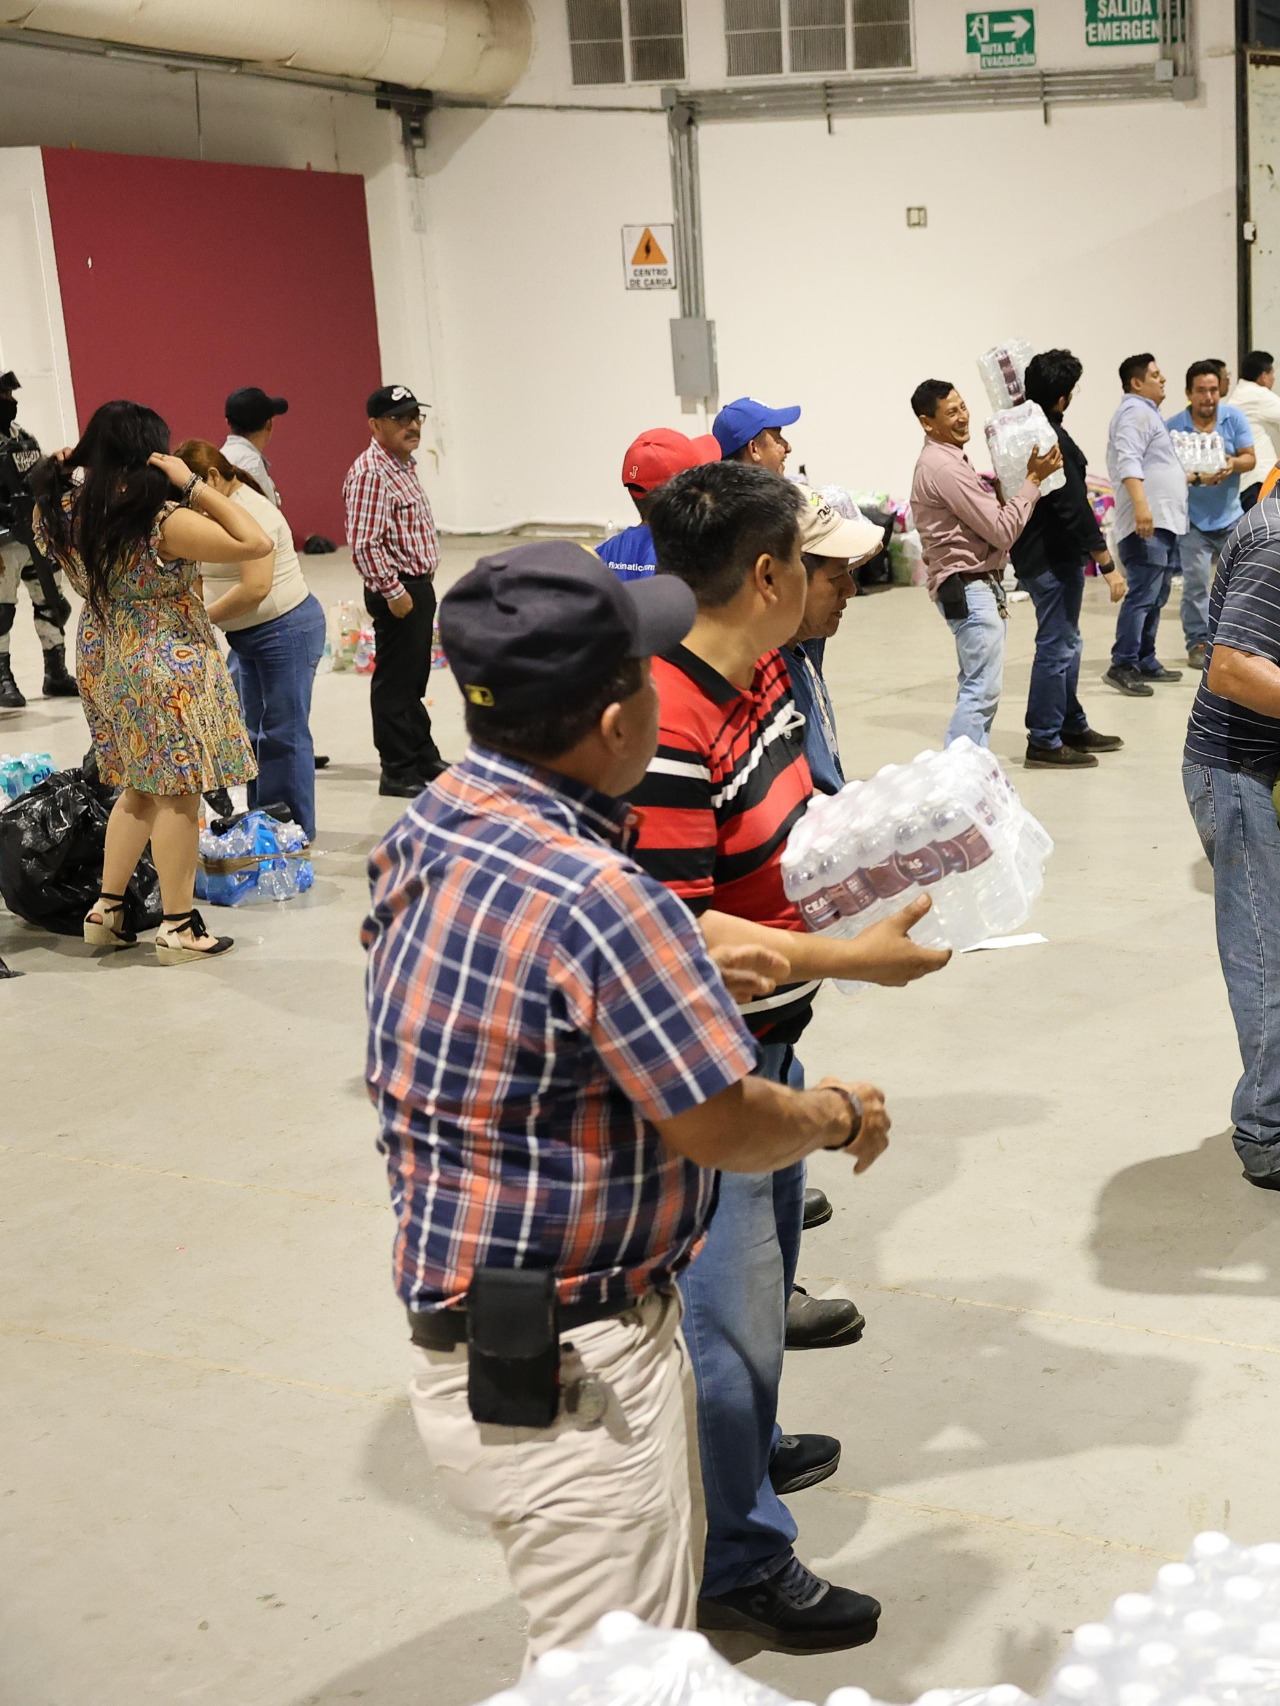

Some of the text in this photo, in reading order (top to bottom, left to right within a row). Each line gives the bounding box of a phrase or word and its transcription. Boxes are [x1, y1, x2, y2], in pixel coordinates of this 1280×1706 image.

[1097, 0, 1153, 18] SALIDA
[1087, 19, 1163, 42] EMERGEN
[633, 268, 668, 277] CENTRO
[629, 278, 672, 287] DE CARGA
